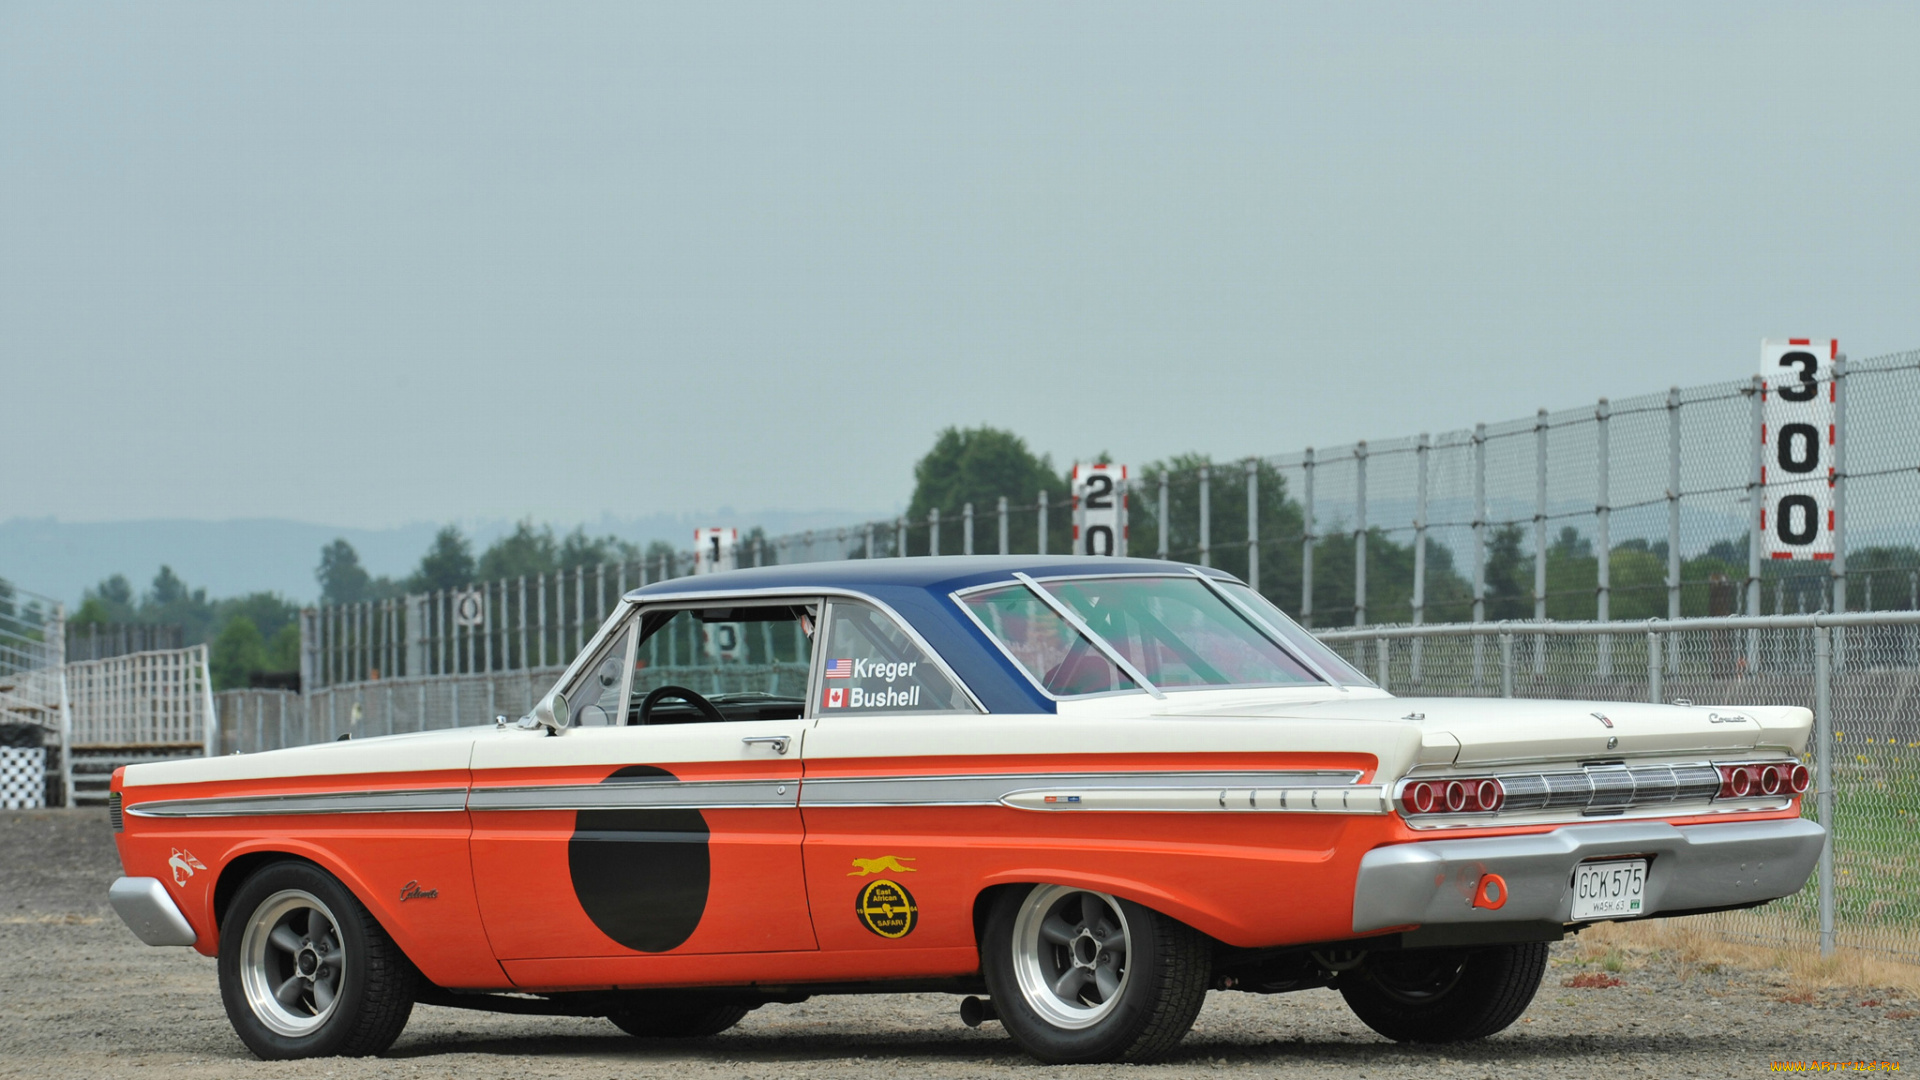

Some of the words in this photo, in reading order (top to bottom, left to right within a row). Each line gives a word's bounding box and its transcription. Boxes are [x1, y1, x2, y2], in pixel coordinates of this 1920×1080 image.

[1777, 351, 1819, 545] 300
[853, 658, 916, 682] Kreger
[850, 686, 920, 708] Bushell
[1579, 870, 1609, 899] GCK
[1612, 868, 1642, 897] 575
